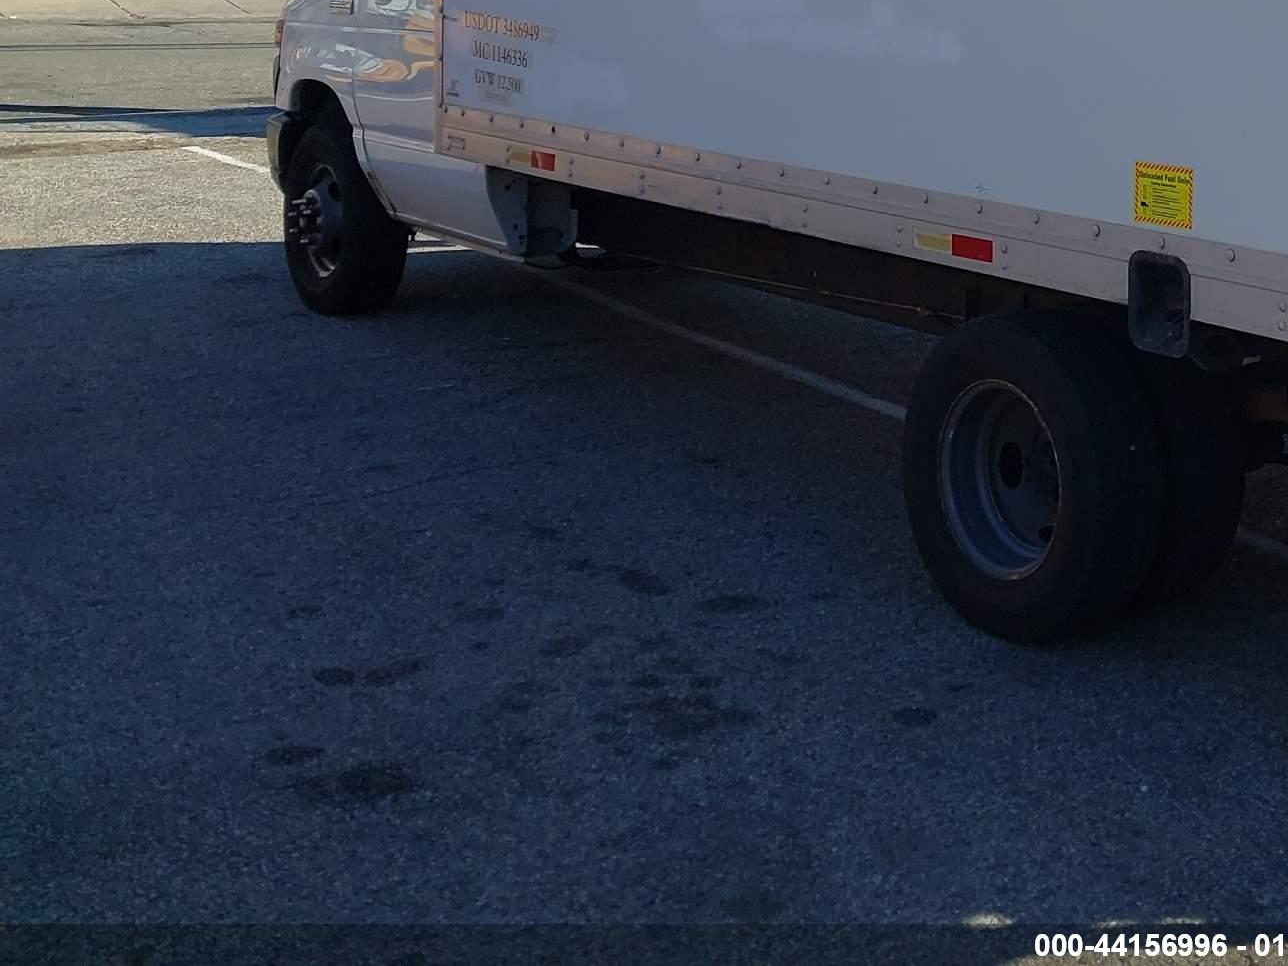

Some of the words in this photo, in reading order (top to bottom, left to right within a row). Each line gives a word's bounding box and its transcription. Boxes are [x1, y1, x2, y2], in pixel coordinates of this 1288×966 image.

[464, 10, 500, 33] USDOT
[472, 40, 490, 60] MC
[492, 44, 528, 68] 1146336
[475, 68, 496, 87] GVW
